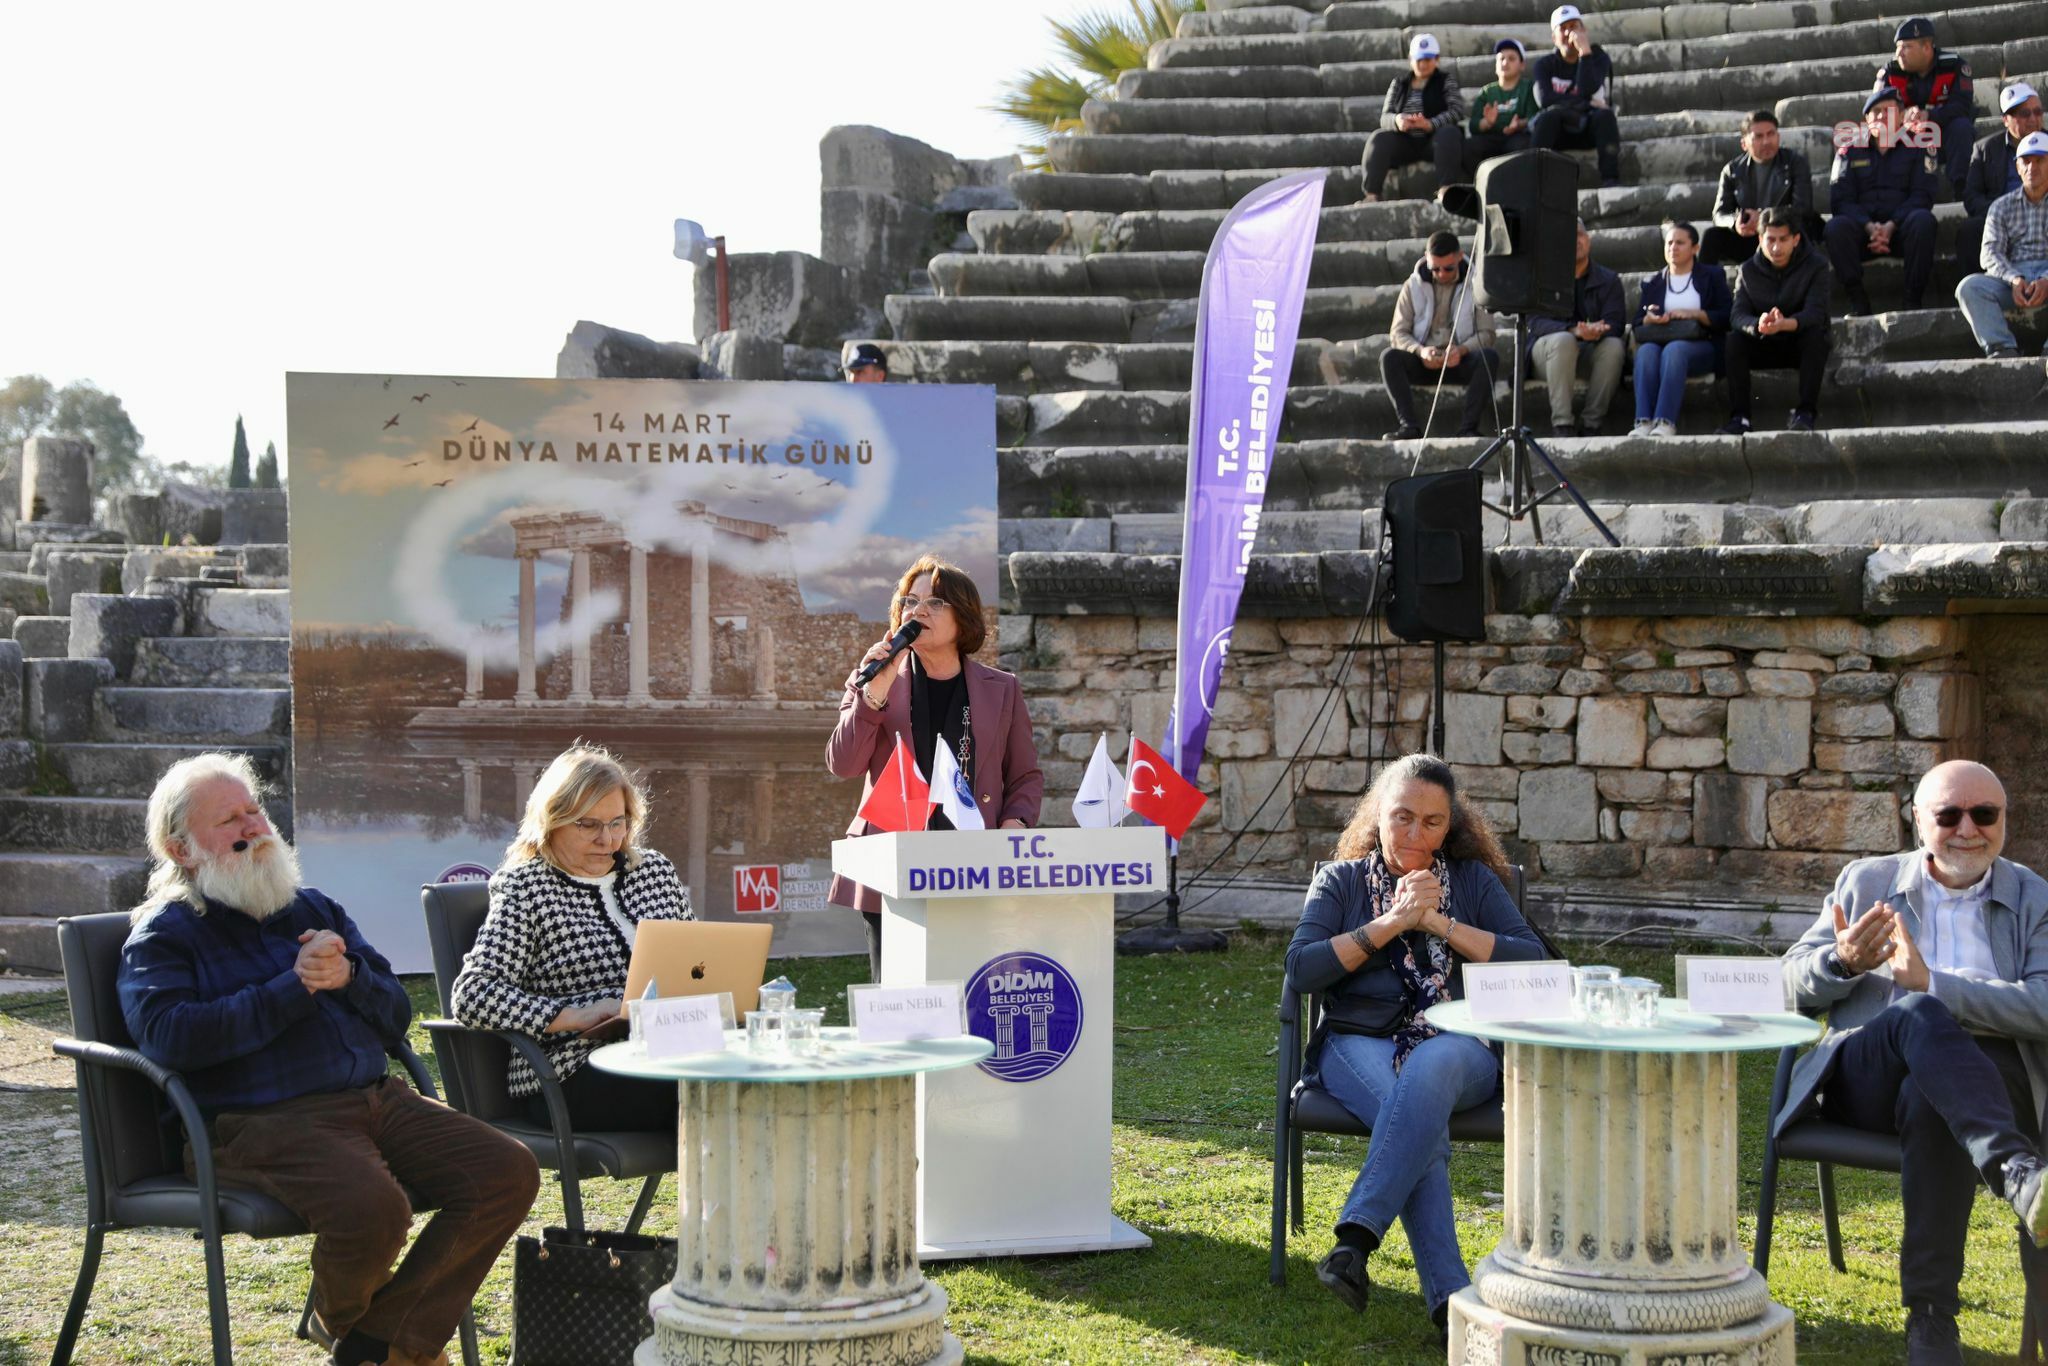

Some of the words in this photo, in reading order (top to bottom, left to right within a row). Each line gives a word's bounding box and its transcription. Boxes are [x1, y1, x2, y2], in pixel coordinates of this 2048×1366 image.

[1245, 299, 1276, 494] BELEDİYESİ
[593, 412, 626, 433] 14
[644, 412, 732, 434] MART
[443, 436, 558, 461] DÜNYA
[576, 438, 769, 464] MATEMATİK
[784, 440, 873, 465] GÜNÜ
[1217, 418, 1241, 478] T.C.
[1007, 835, 1055, 858] T.C.
[909, 866, 990, 891] DİDİM
[998, 862, 1153, 889] BELEDİYESİ
[988, 969, 1054, 994] DİDİM
[1511, 976, 1559, 991] TANBAY
[1701, 971, 1729, 984] Talat
[990, 990, 1054, 1005] BELEDİYESİ
